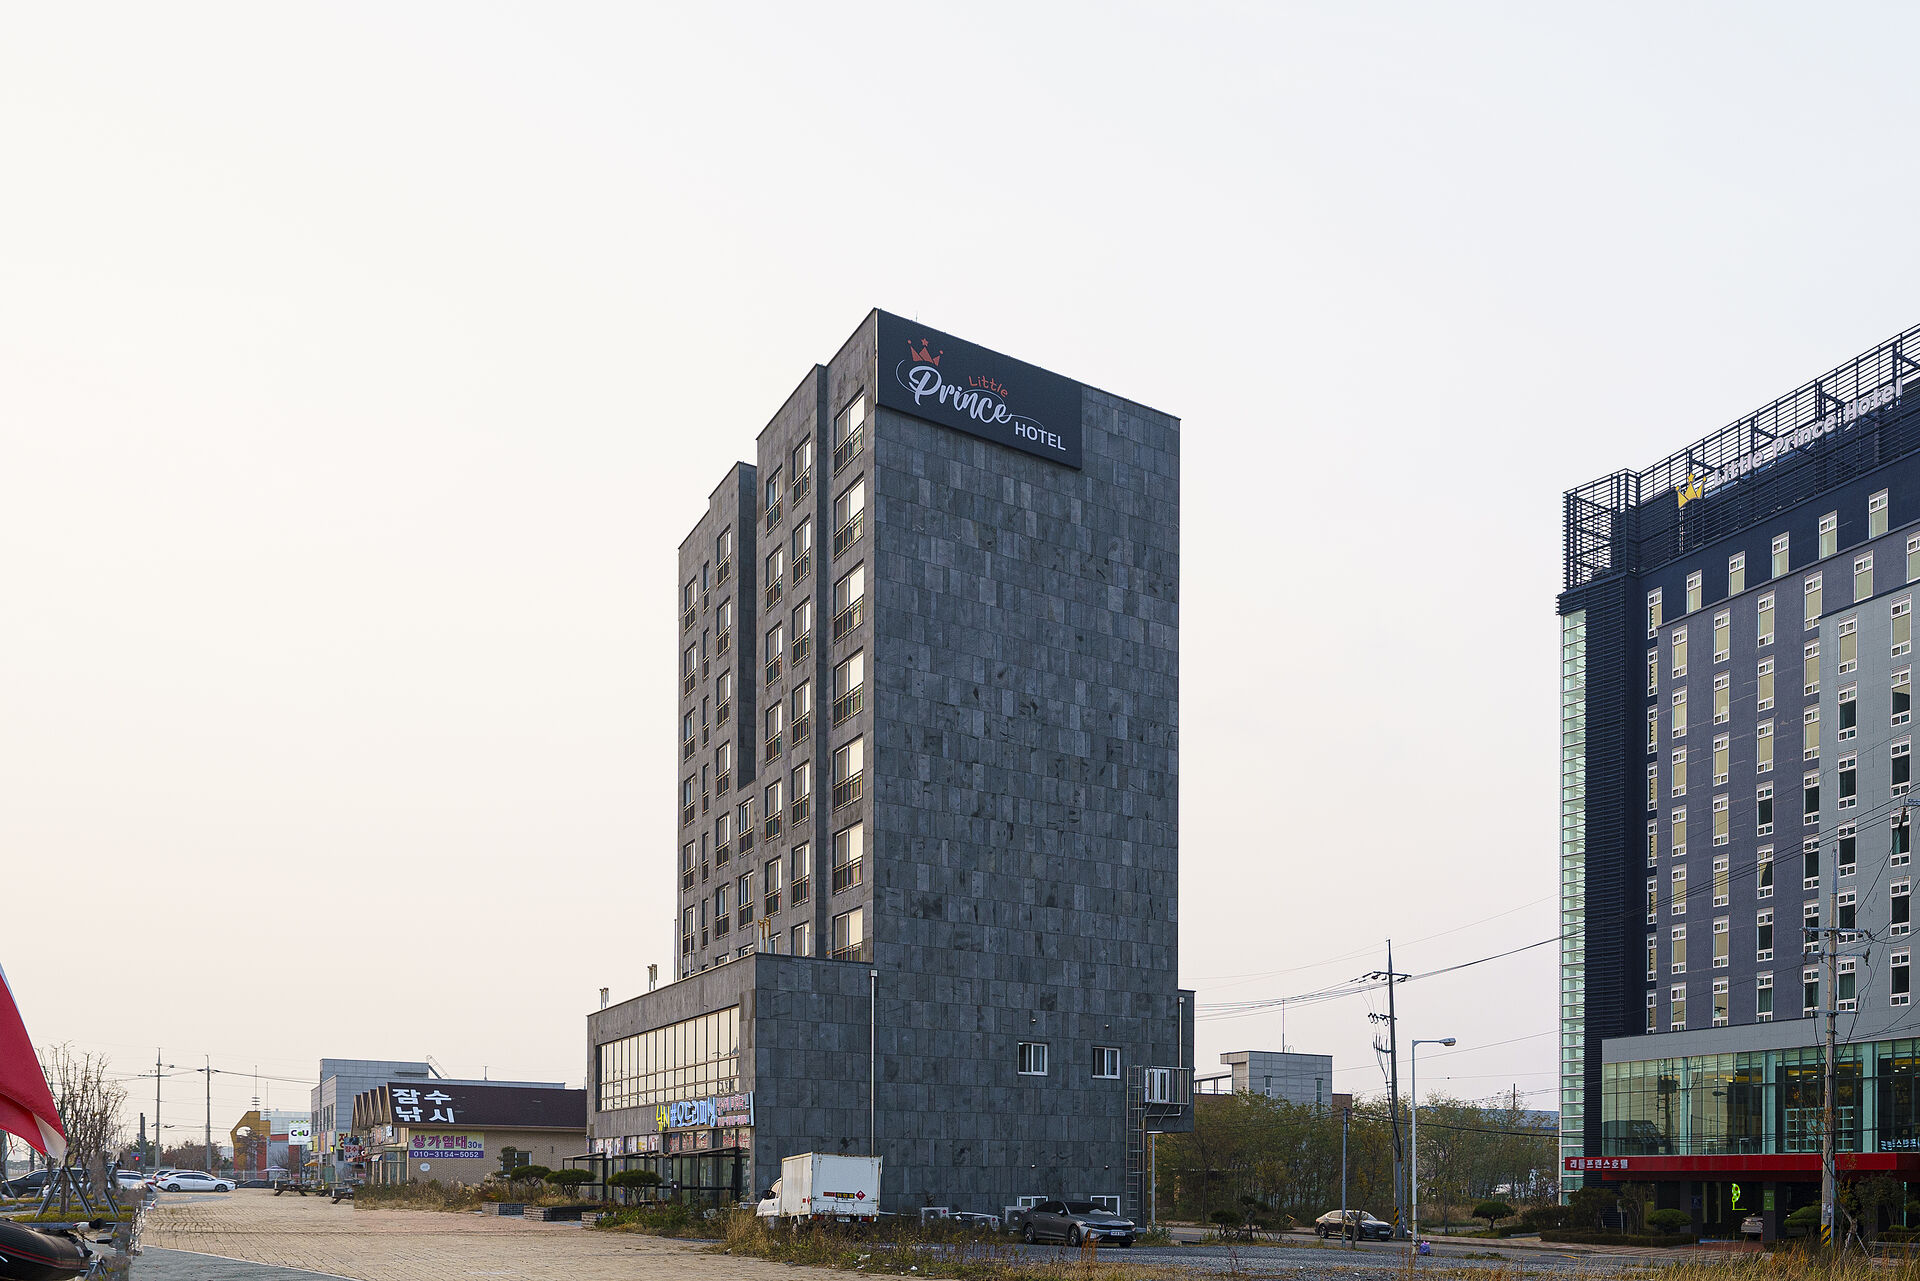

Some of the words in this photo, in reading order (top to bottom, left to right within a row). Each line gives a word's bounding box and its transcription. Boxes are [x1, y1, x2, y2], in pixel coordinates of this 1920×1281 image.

[908, 365, 1013, 424] Prince
[968, 375, 1009, 398] Little
[1015, 421, 1067, 451] HOTEL
[1713, 450, 1764, 487] Little
[1771, 414, 1837, 458] Prince
[1843, 378, 1903, 423] Hotel
[392, 1088, 452, 1105] 잠수
[395, 1106, 455, 1123] 낚시
[412, 1135, 468, 1149] 상가임대
[413, 1150, 479, 1158] 010-3154-5052
